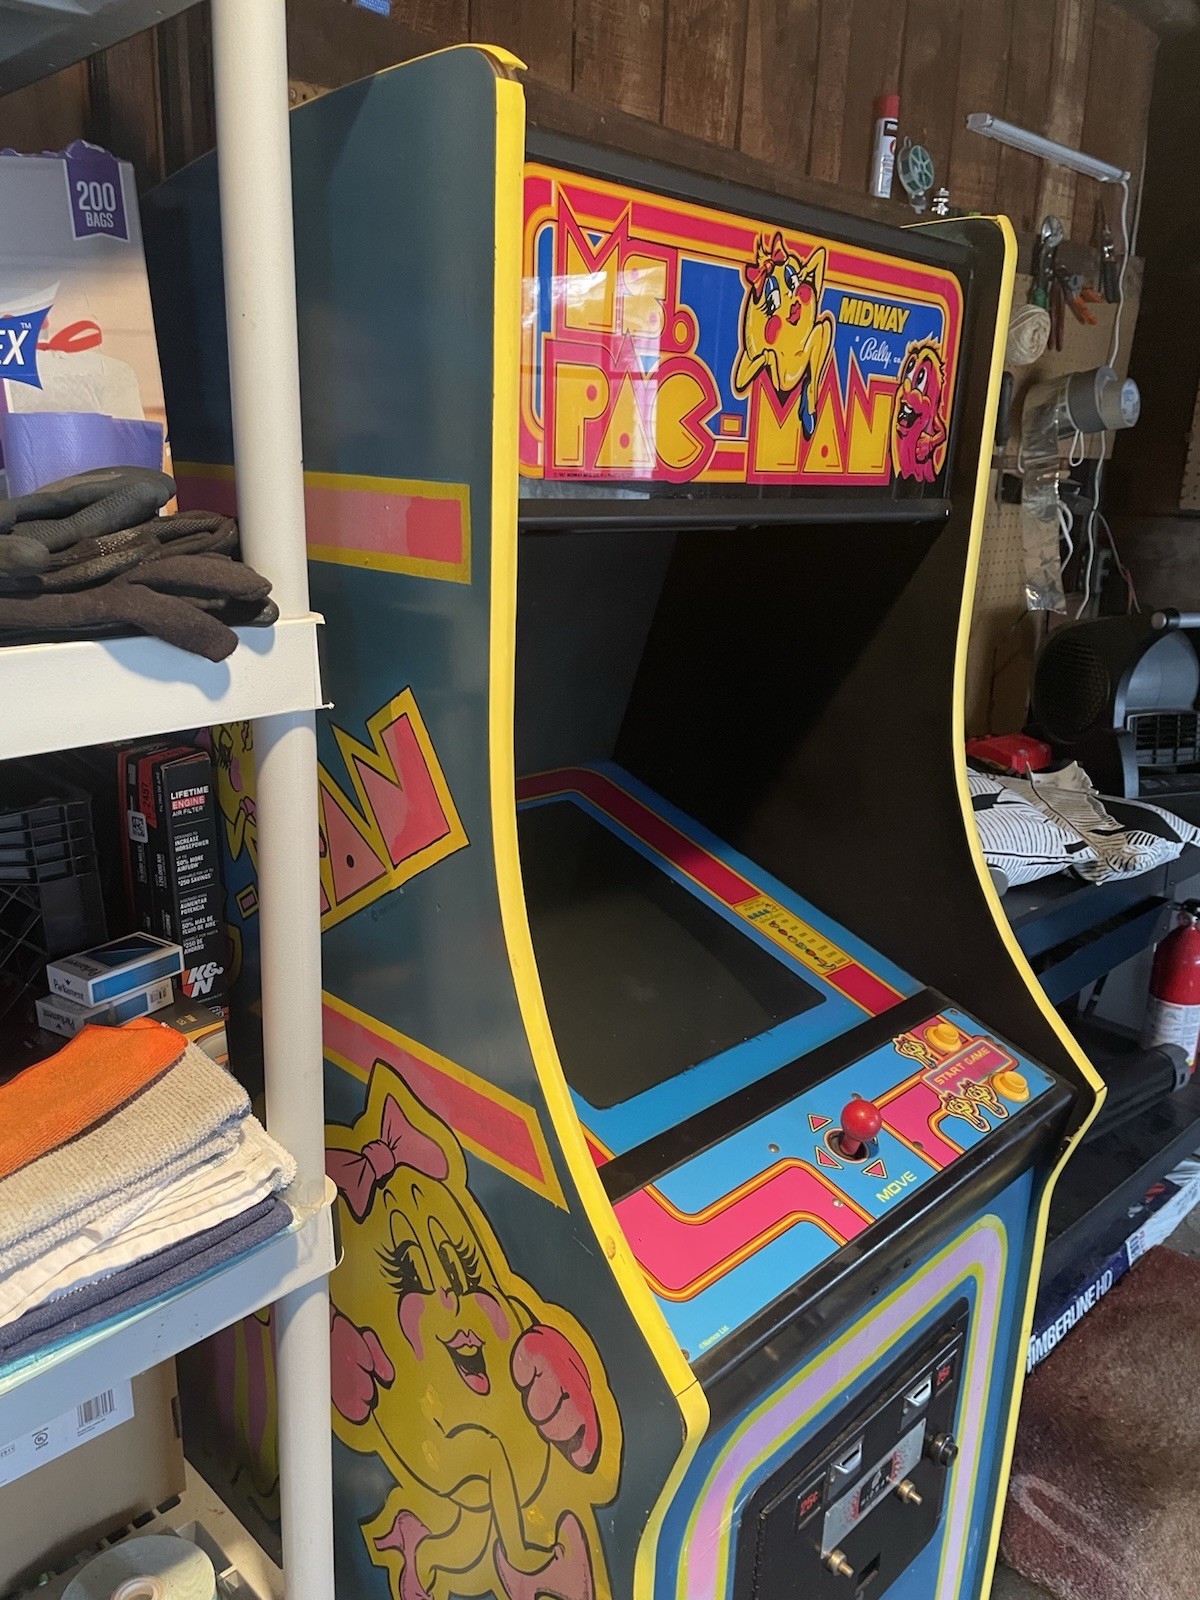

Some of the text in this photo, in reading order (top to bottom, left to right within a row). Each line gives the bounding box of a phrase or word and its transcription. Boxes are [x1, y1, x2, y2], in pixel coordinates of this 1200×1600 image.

[76, 181, 116, 211] 200
[85, 211, 114, 228] BAGS
[838, 296, 910, 334] MIDWAY
[860, 337, 892, 370] Bally
[170, 785, 209, 800] LIFETIME
[171, 795, 206, 811] ENGINE
[172, 806, 204, 818] AIR FILTER
[174, 835, 199, 847] INCREASE
[174, 839, 210, 852] HORSEPOWER
[176, 854, 204, 867] 50% MORE
[180, 897, 207, 909] AUMENTAR
[181, 904, 205, 915] POTENCIA
[181, 922, 194, 930] 50%
[933, 1046, 990, 1086] START GAME
[875, 1170, 917, 1203] MOVE
[1095, 1269, 1114, 1301] HD
